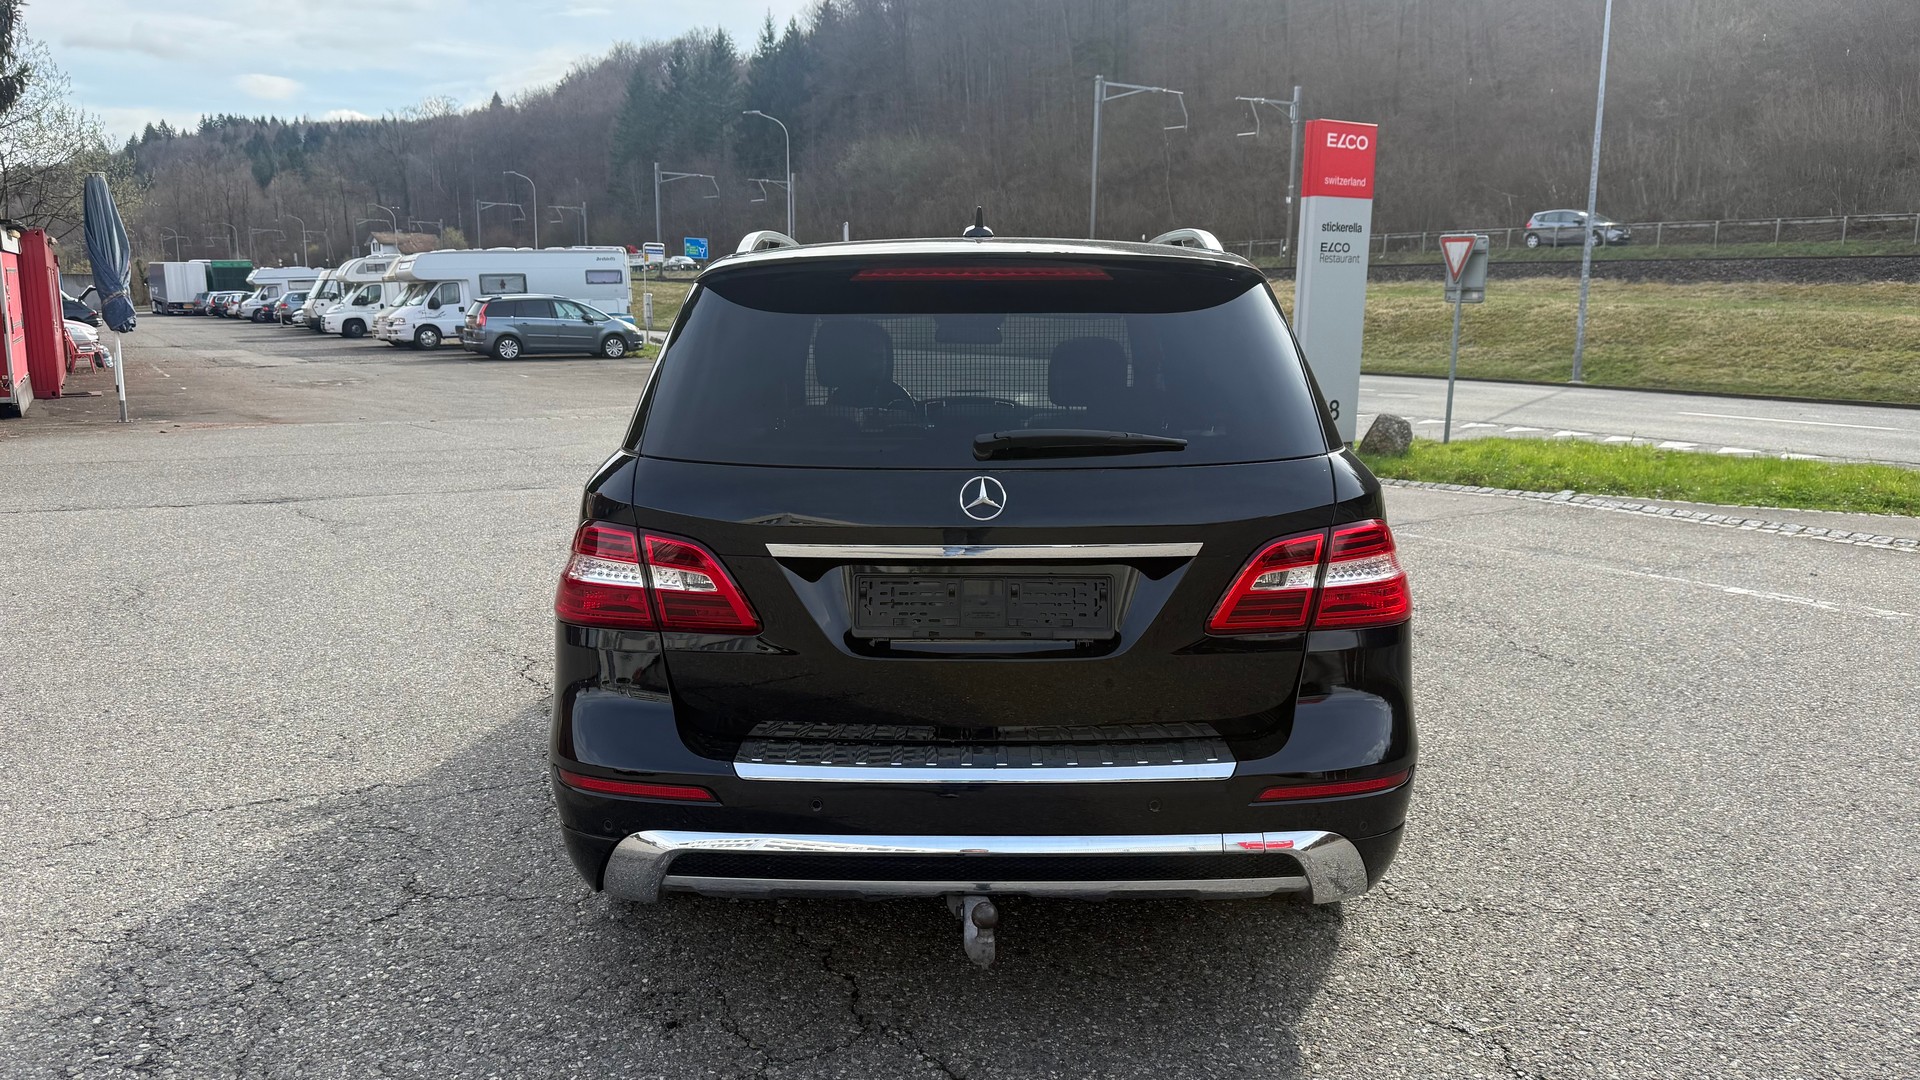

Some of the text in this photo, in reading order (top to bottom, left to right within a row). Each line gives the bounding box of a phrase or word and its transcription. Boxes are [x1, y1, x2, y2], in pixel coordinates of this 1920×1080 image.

[1326, 132, 1369, 150] ELCO
[1324, 175, 1366, 187] switzerland
[1321, 221, 1363, 233] stickerella
[1320, 242, 1351, 253] ELCO
[1319, 253, 1360, 264] Restaurant
